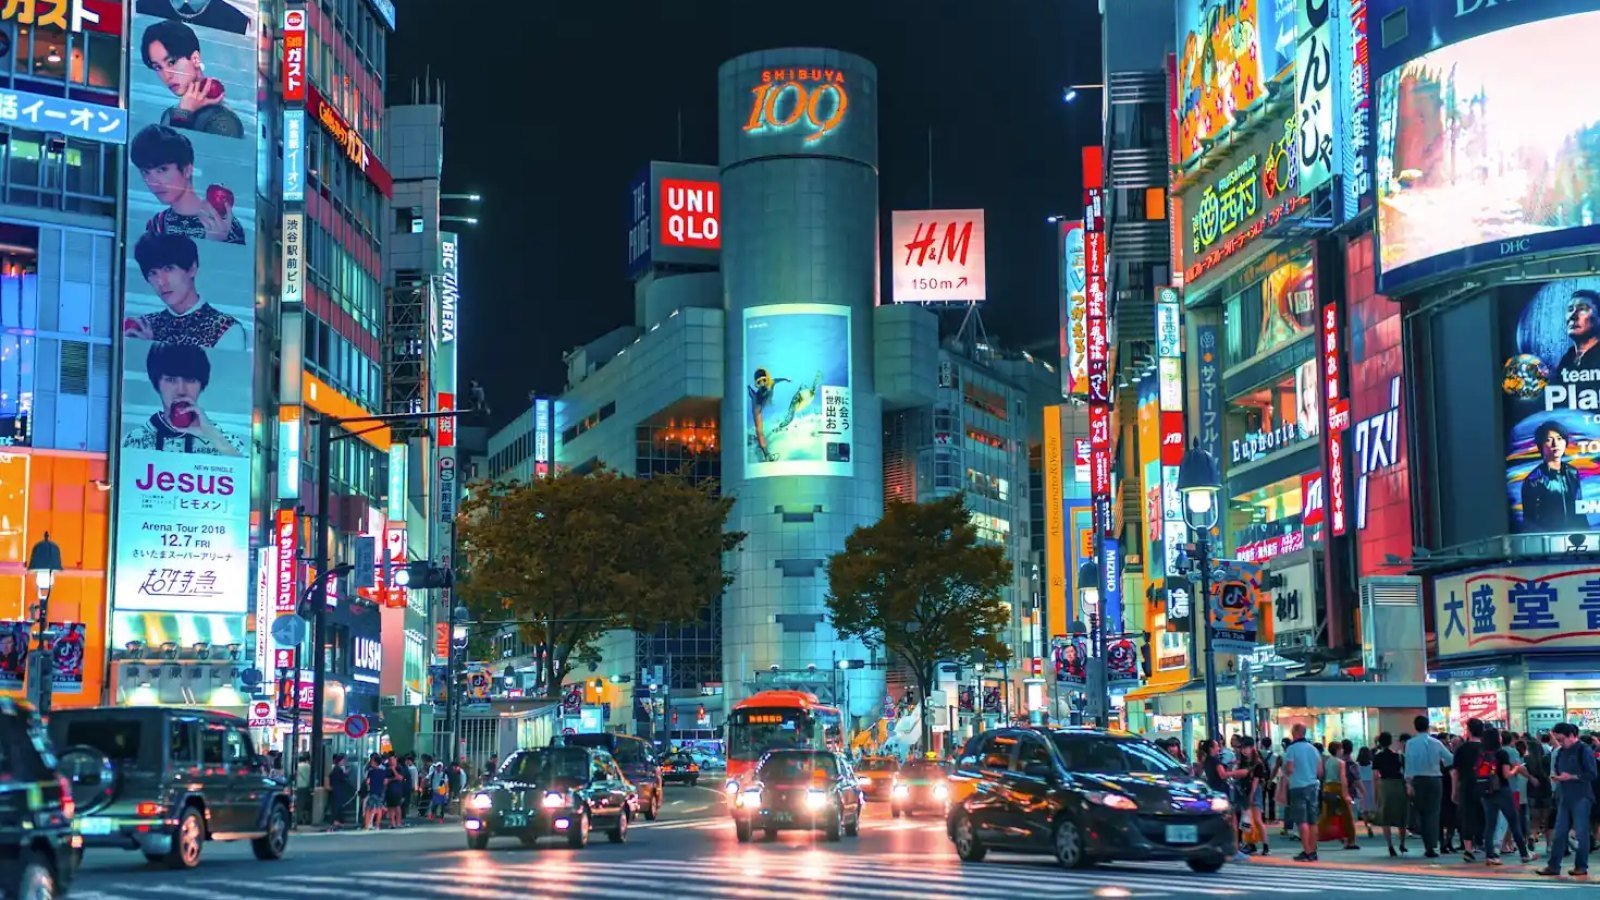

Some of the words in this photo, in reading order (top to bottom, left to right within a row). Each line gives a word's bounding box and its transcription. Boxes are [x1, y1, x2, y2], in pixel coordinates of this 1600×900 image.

[287, 48, 301, 91] ガスト
[761, 69, 845, 83] SHIBUYA
[742, 81, 848, 146] 109
[668, 187, 714, 213] UNI
[668, 215, 719, 242] QLO
[286, 219, 298, 294] 渋谷駅前ビル
[442, 241, 455, 267] BIC
[904, 221, 973, 267] H&M
[1500, 239, 1530, 255] DHC
[1201, 365, 1218, 458] サマーフルー
[1545, 385, 1600, 412] Pla
[1164, 432, 1182, 444] JTB
[1232, 419, 1296, 462] Euphoria
[136, 464, 234, 495] Jesus
[142, 522, 172, 531] Arena
[177, 524, 198, 533] Tour
[201, 525, 226, 534] 2018
[161, 534, 193, 547] 12.7
[195, 540, 210, 548] FRI
[132, 549, 232, 562] さいたまスーパーアリーナ
[1107, 550, 1117, 592] MIZUHO
[354, 637, 381, 672] LUSH
